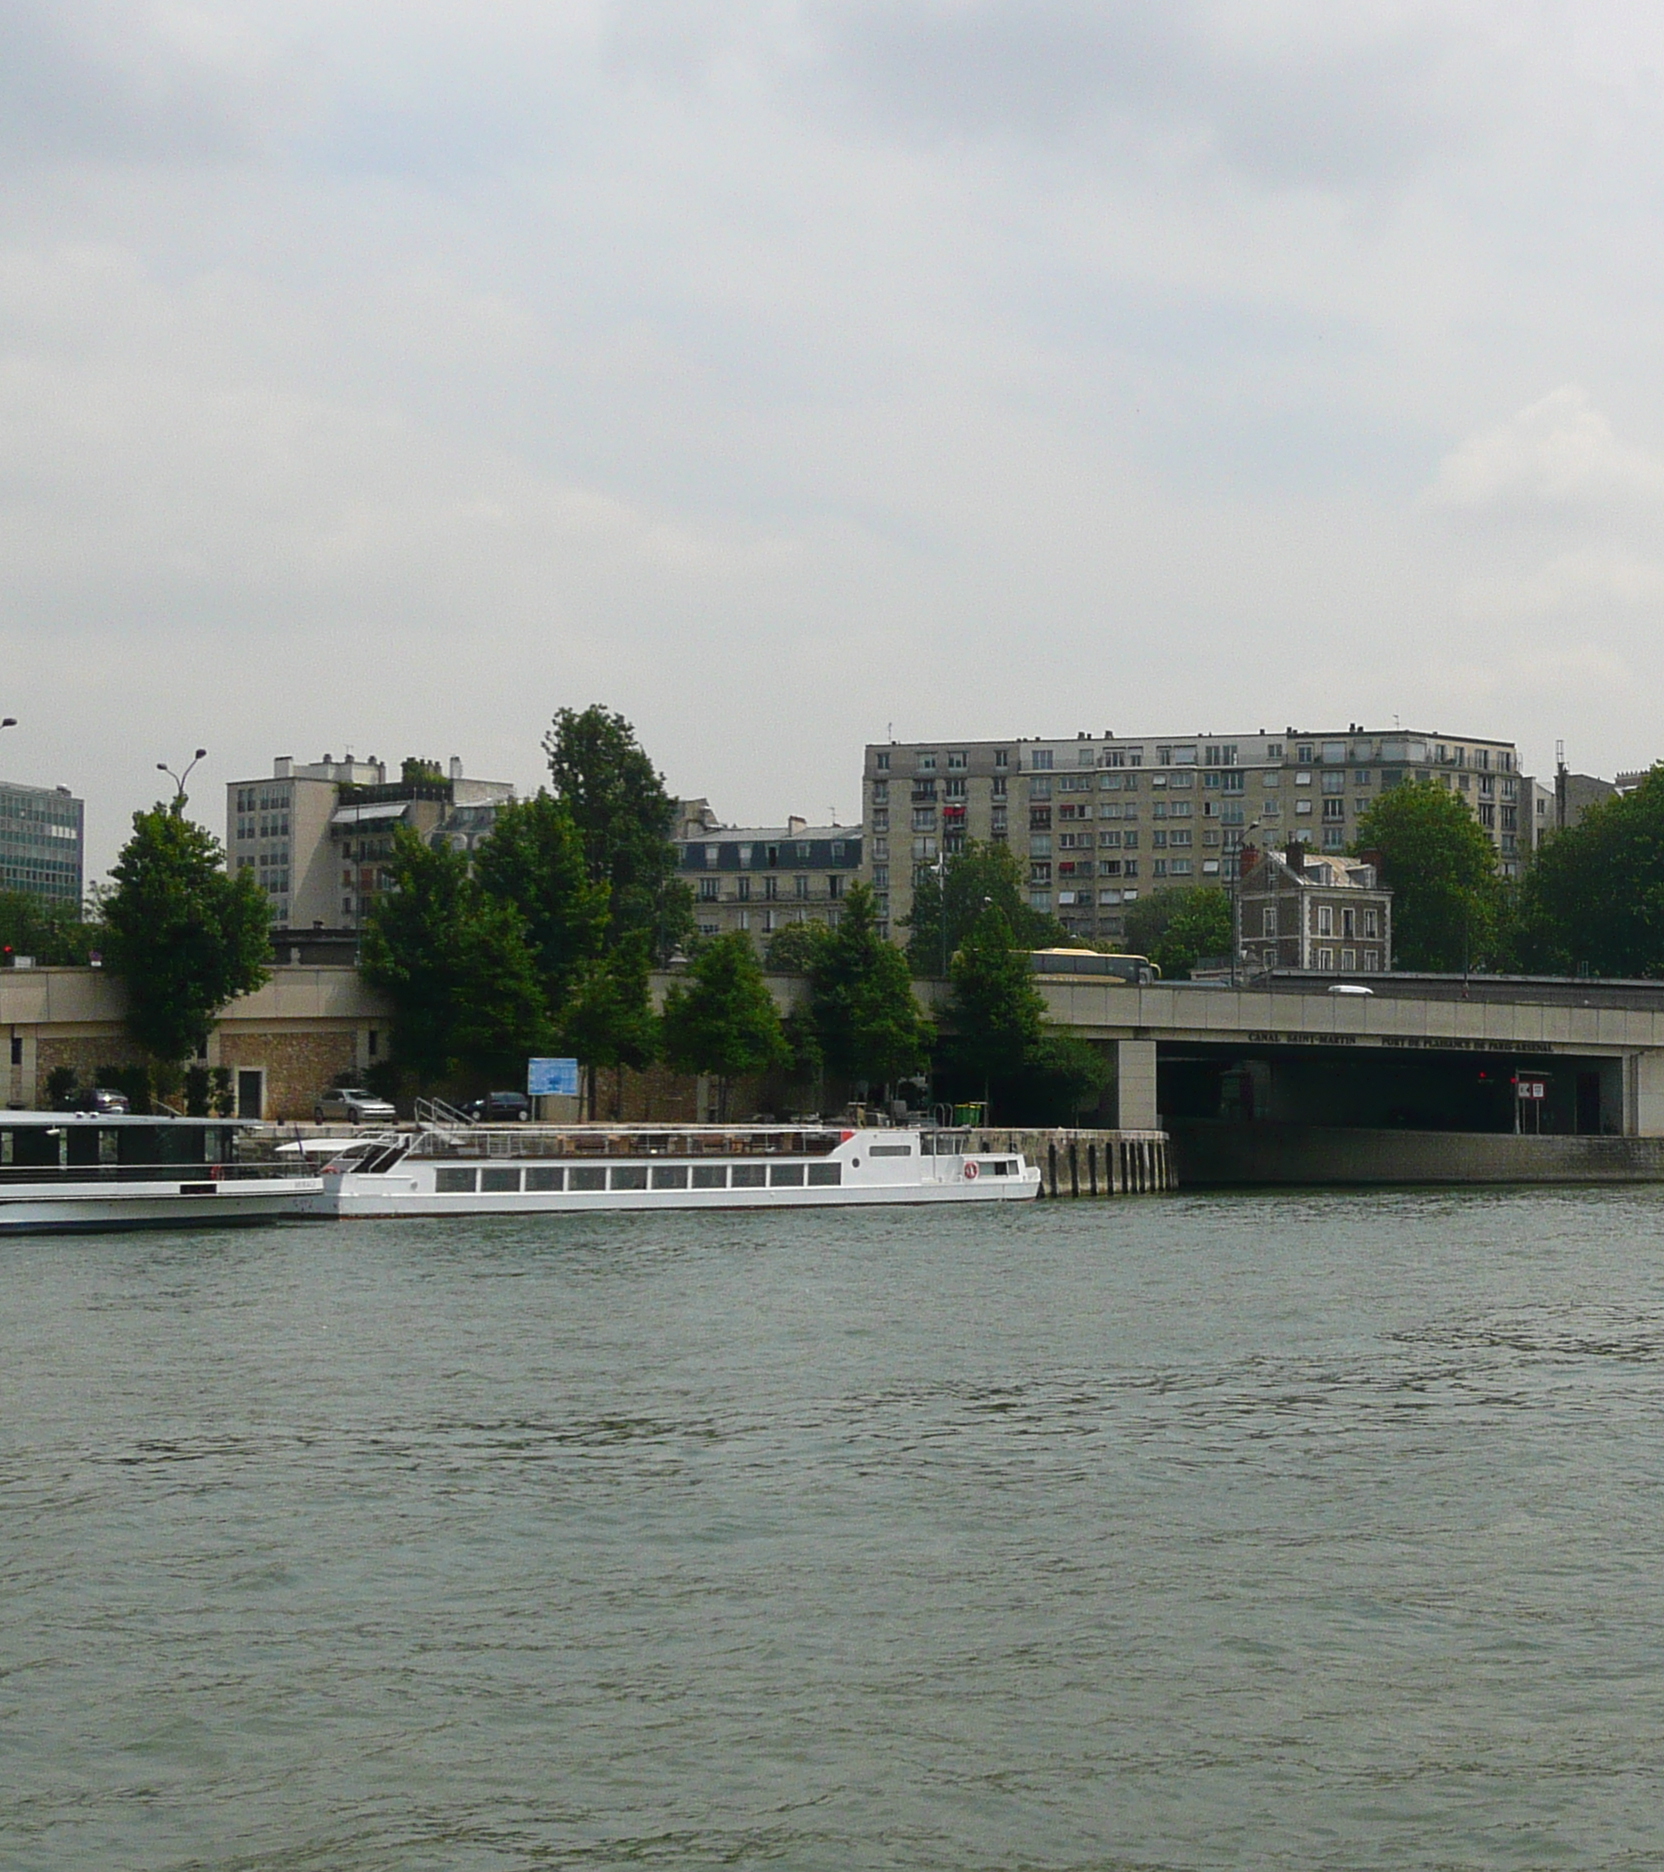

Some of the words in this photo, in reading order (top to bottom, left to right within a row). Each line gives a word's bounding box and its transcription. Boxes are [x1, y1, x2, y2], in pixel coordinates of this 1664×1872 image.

[1248, 1032, 1281, 1042] CANAL
[1287, 1034, 1356, 1045] SAINT-MARTIN
[1382, 1037, 1405, 1047] PORT
[1408, 1038, 1420, 1047] DE
